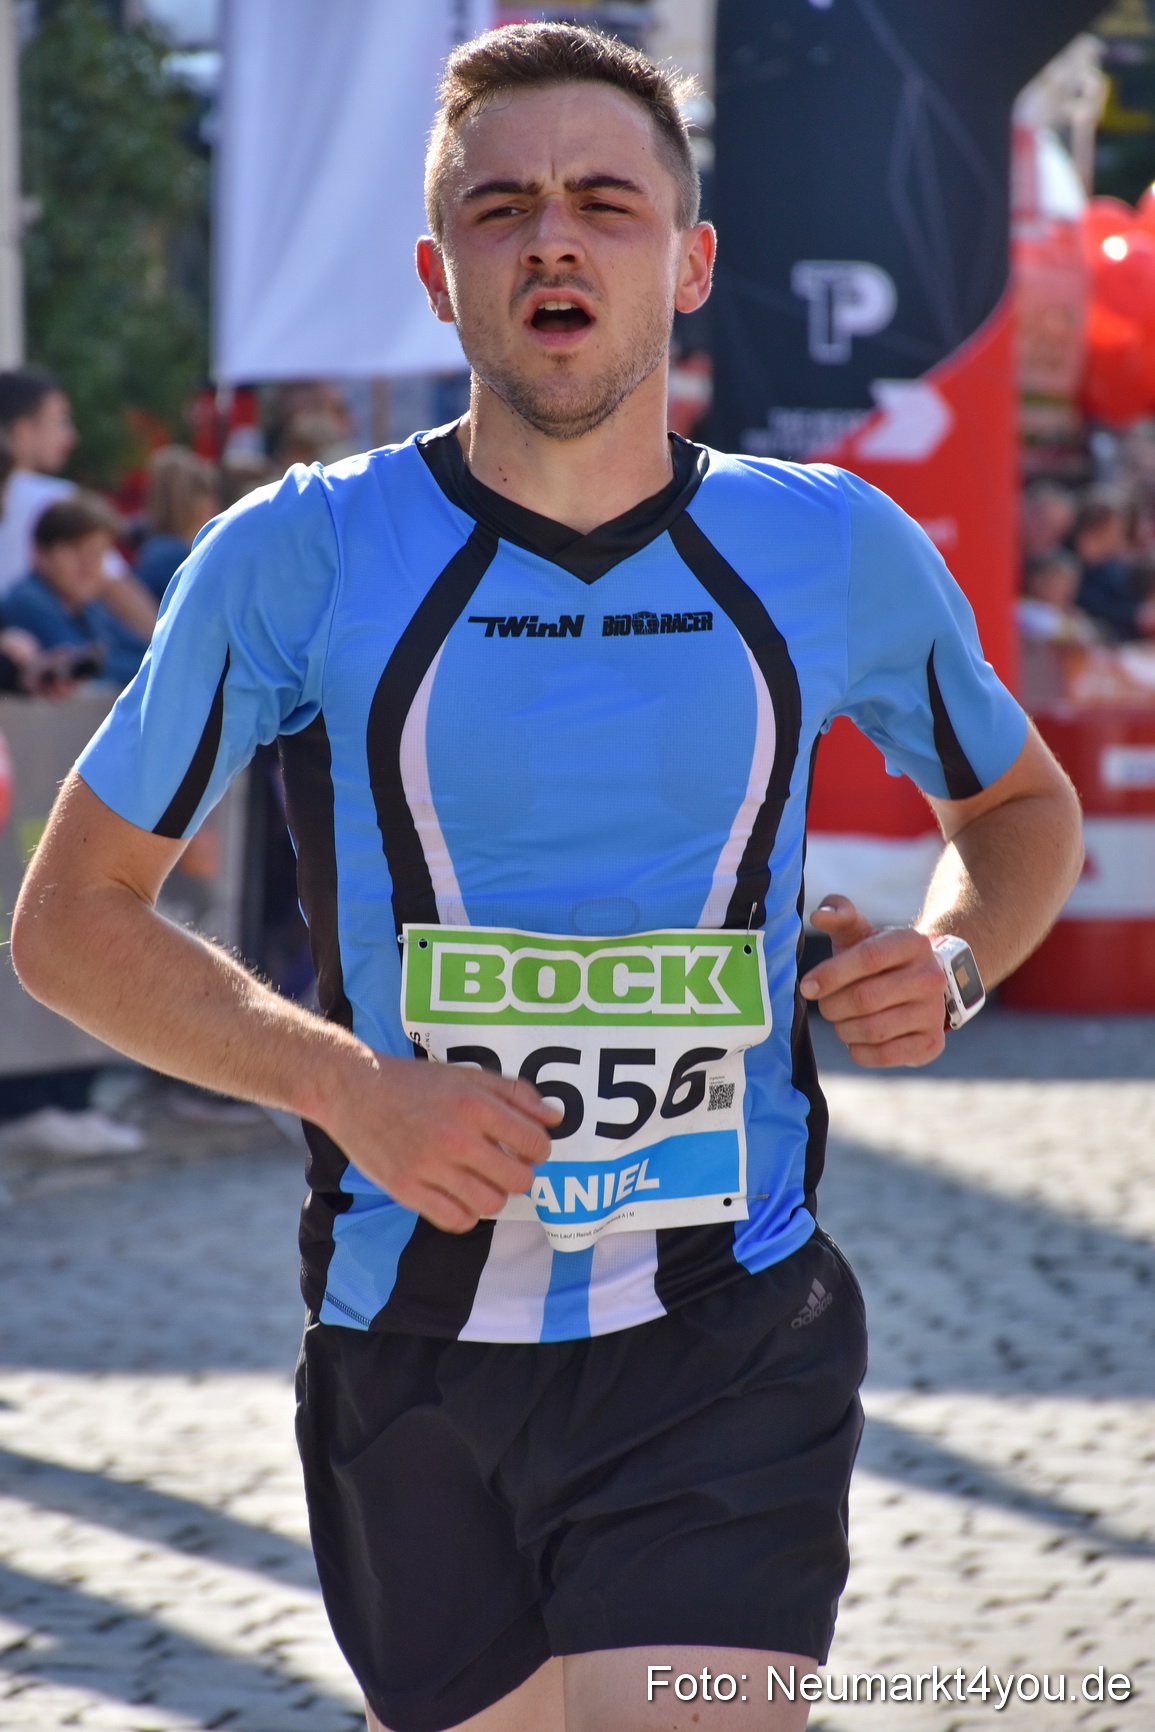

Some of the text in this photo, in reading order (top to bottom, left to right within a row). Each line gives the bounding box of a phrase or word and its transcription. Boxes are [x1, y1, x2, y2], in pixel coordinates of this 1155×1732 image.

[435, 948, 730, 1009] BOCK
[446, 1045, 728, 1140] 656
[533, 1158, 660, 1213] ANIEL
[790, 1291, 834, 1330] adidas
